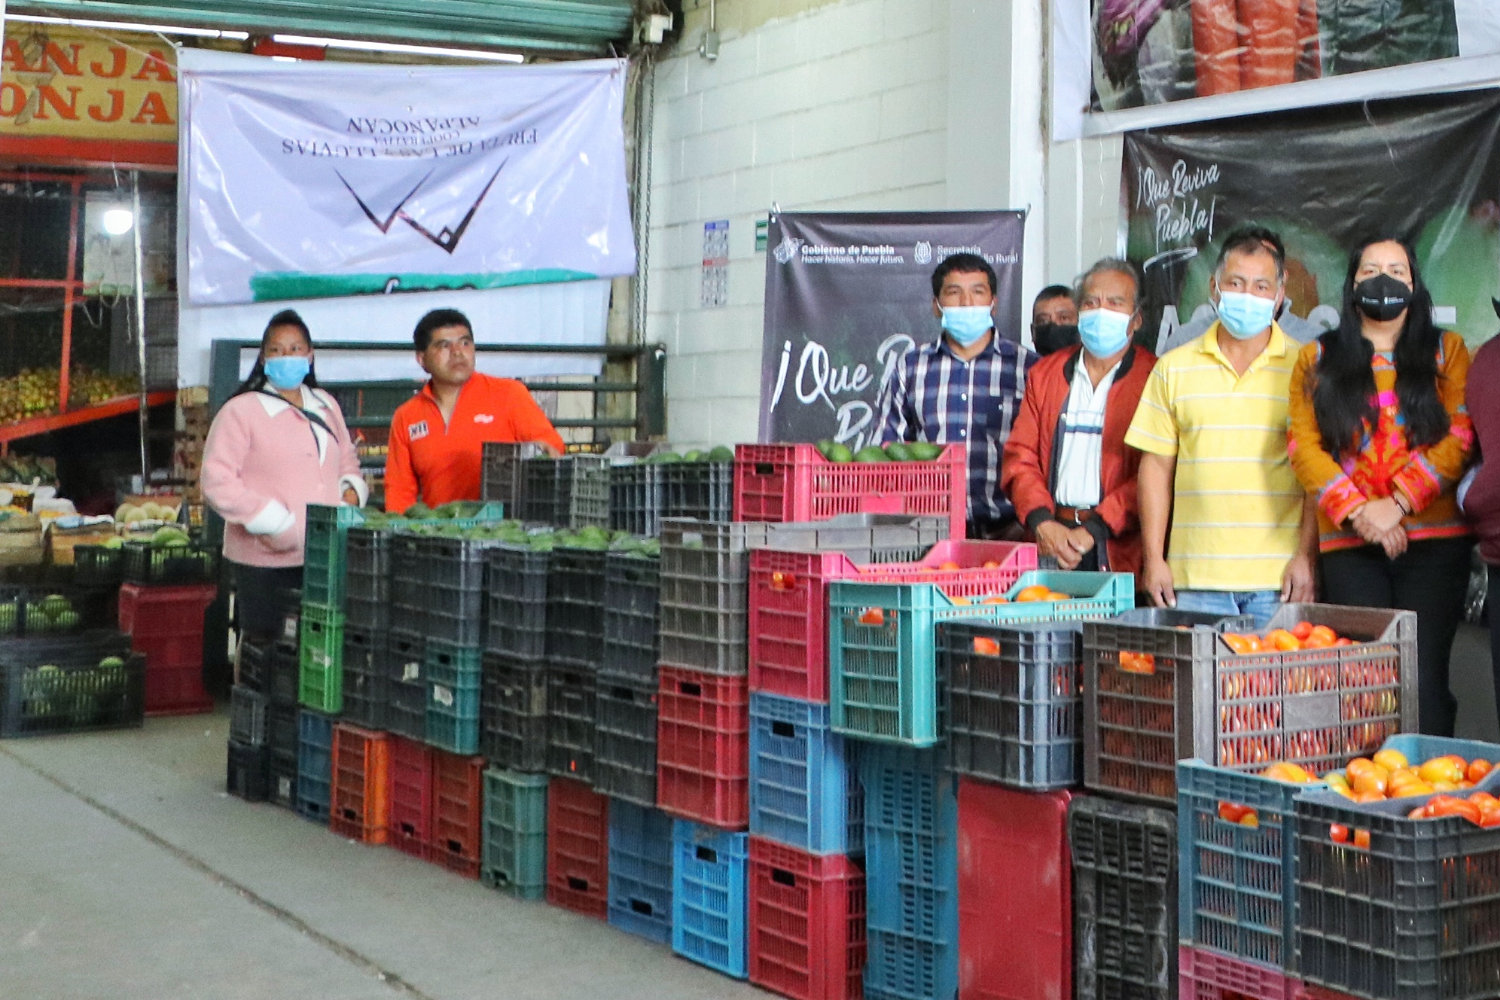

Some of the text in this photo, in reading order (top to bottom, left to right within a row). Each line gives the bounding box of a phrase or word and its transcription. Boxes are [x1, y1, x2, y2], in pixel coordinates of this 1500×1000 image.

[347, 116, 479, 134] ALPANOCAN
[1171, 159, 1220, 208] Reviva
[1156, 194, 1215, 253] Puebla!
[802, 245, 894, 255] Gobierno de Puebla
[996, 253, 1018, 264] Rural
[770, 340, 873, 413] ¡Que
